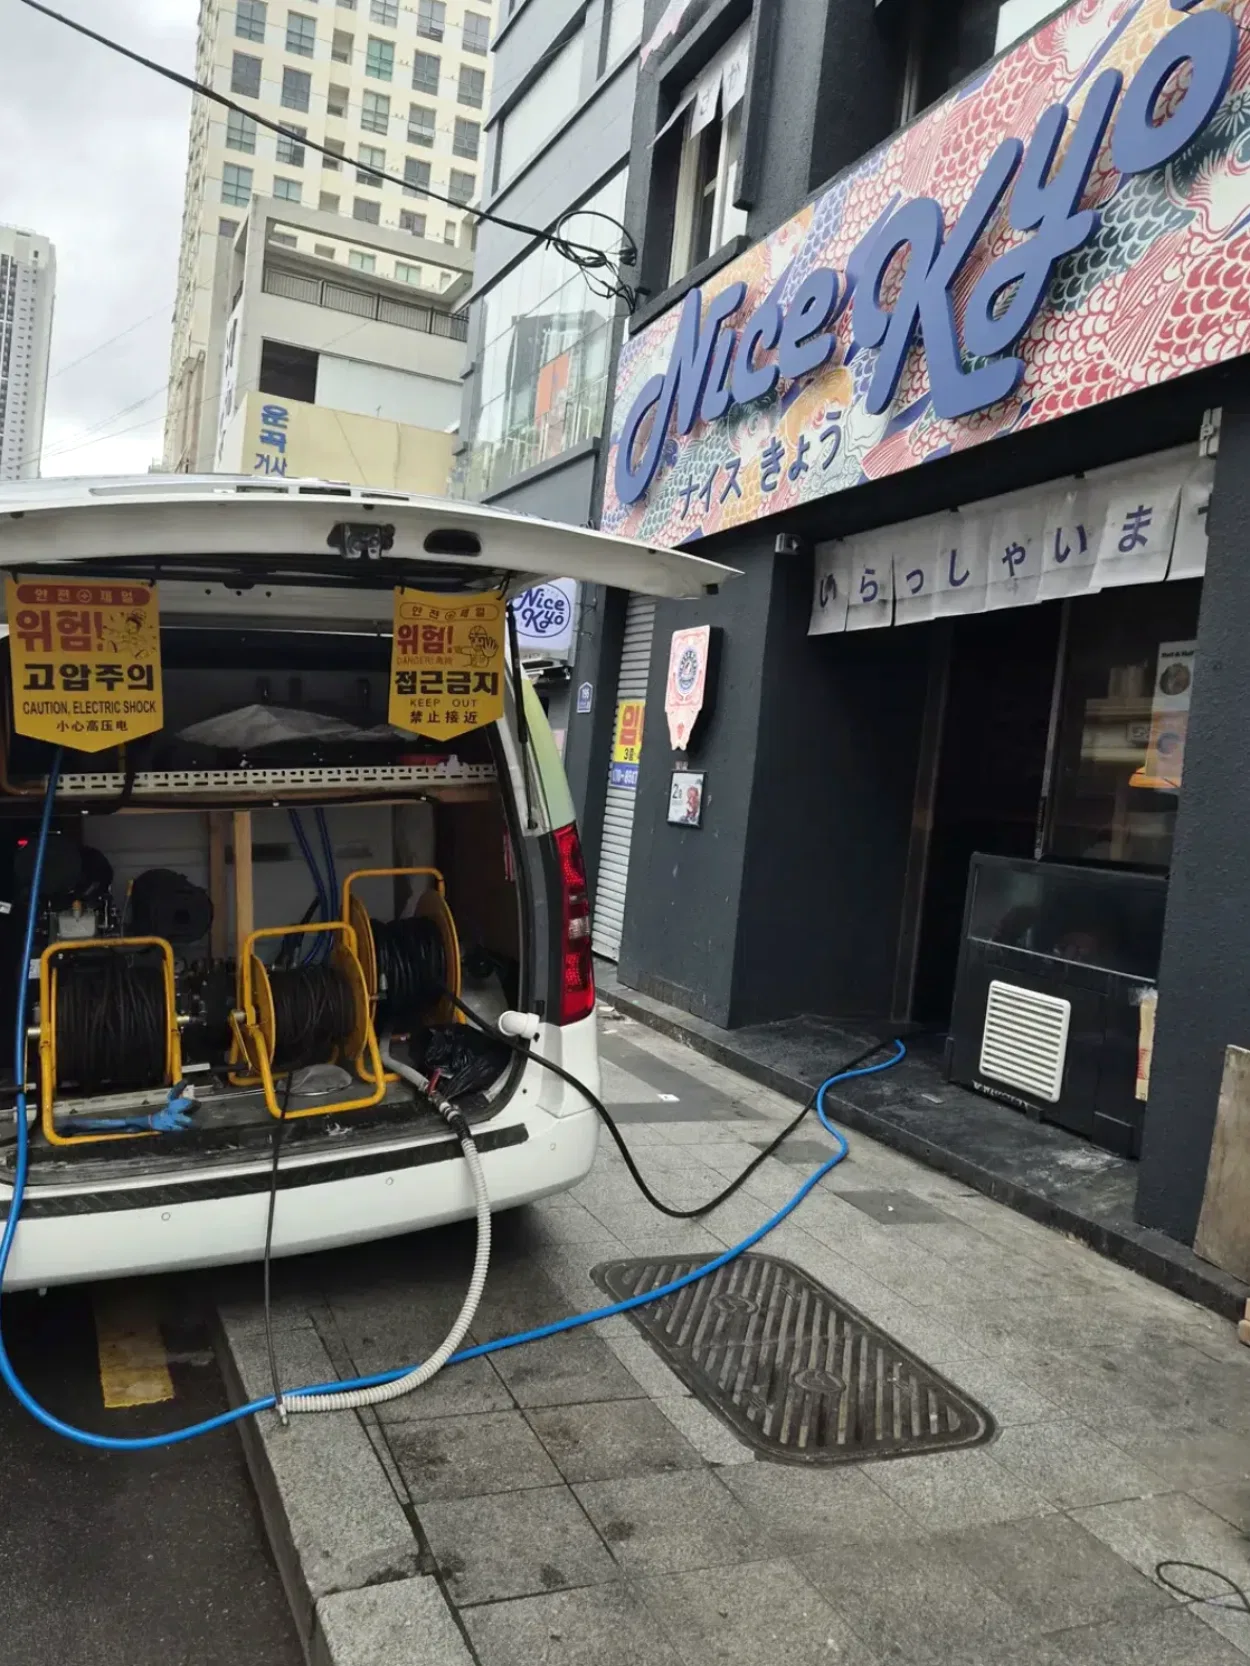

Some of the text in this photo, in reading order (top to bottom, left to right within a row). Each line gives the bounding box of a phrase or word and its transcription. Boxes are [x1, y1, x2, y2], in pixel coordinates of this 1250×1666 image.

[614, 266, 850, 506] Nice
[679, 410, 842, 520] ナイス きょう
[819, 504, 1209, 608] いらっしゃいま
[513, 587, 565, 612] Nice
[16, 609, 104, 652] 위험!
[397, 623, 455, 655] 위험!
[23, 663, 154, 691] 고압주의
[395, 670, 499, 696] 접근금지
[73, 701, 121, 715] ELECTRIC
[123, 700, 157, 714] SHOCK
[410, 698, 479, 708] KEEP OUT
[56, 719, 129, 733] 小心高压电
[410, 710, 478, 725] 禁止接近
